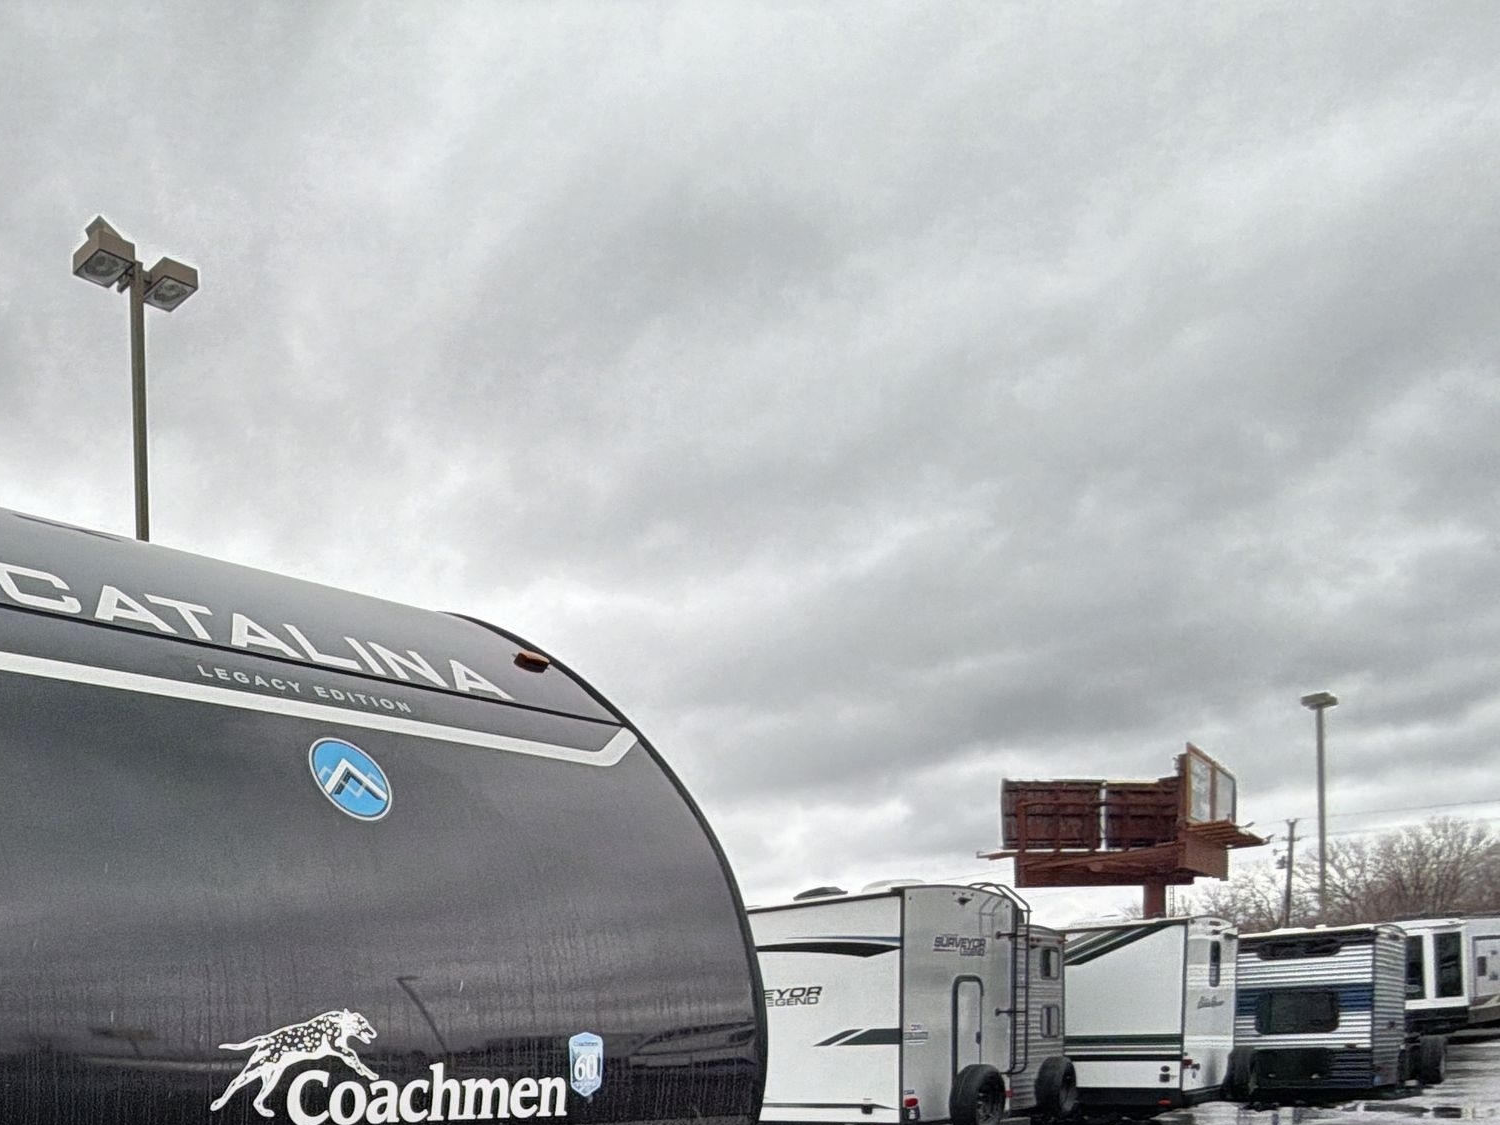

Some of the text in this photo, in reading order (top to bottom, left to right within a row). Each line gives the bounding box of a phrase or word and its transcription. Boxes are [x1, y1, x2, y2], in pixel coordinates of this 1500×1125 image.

[197, 664, 412, 713] LEGACY EDITION
[934, 936, 986, 949] SURVEYOR
[763, 986, 823, 999] EYOR
[766, 997, 819, 1007] EGEND
[574, 1055, 598, 1081] 60
